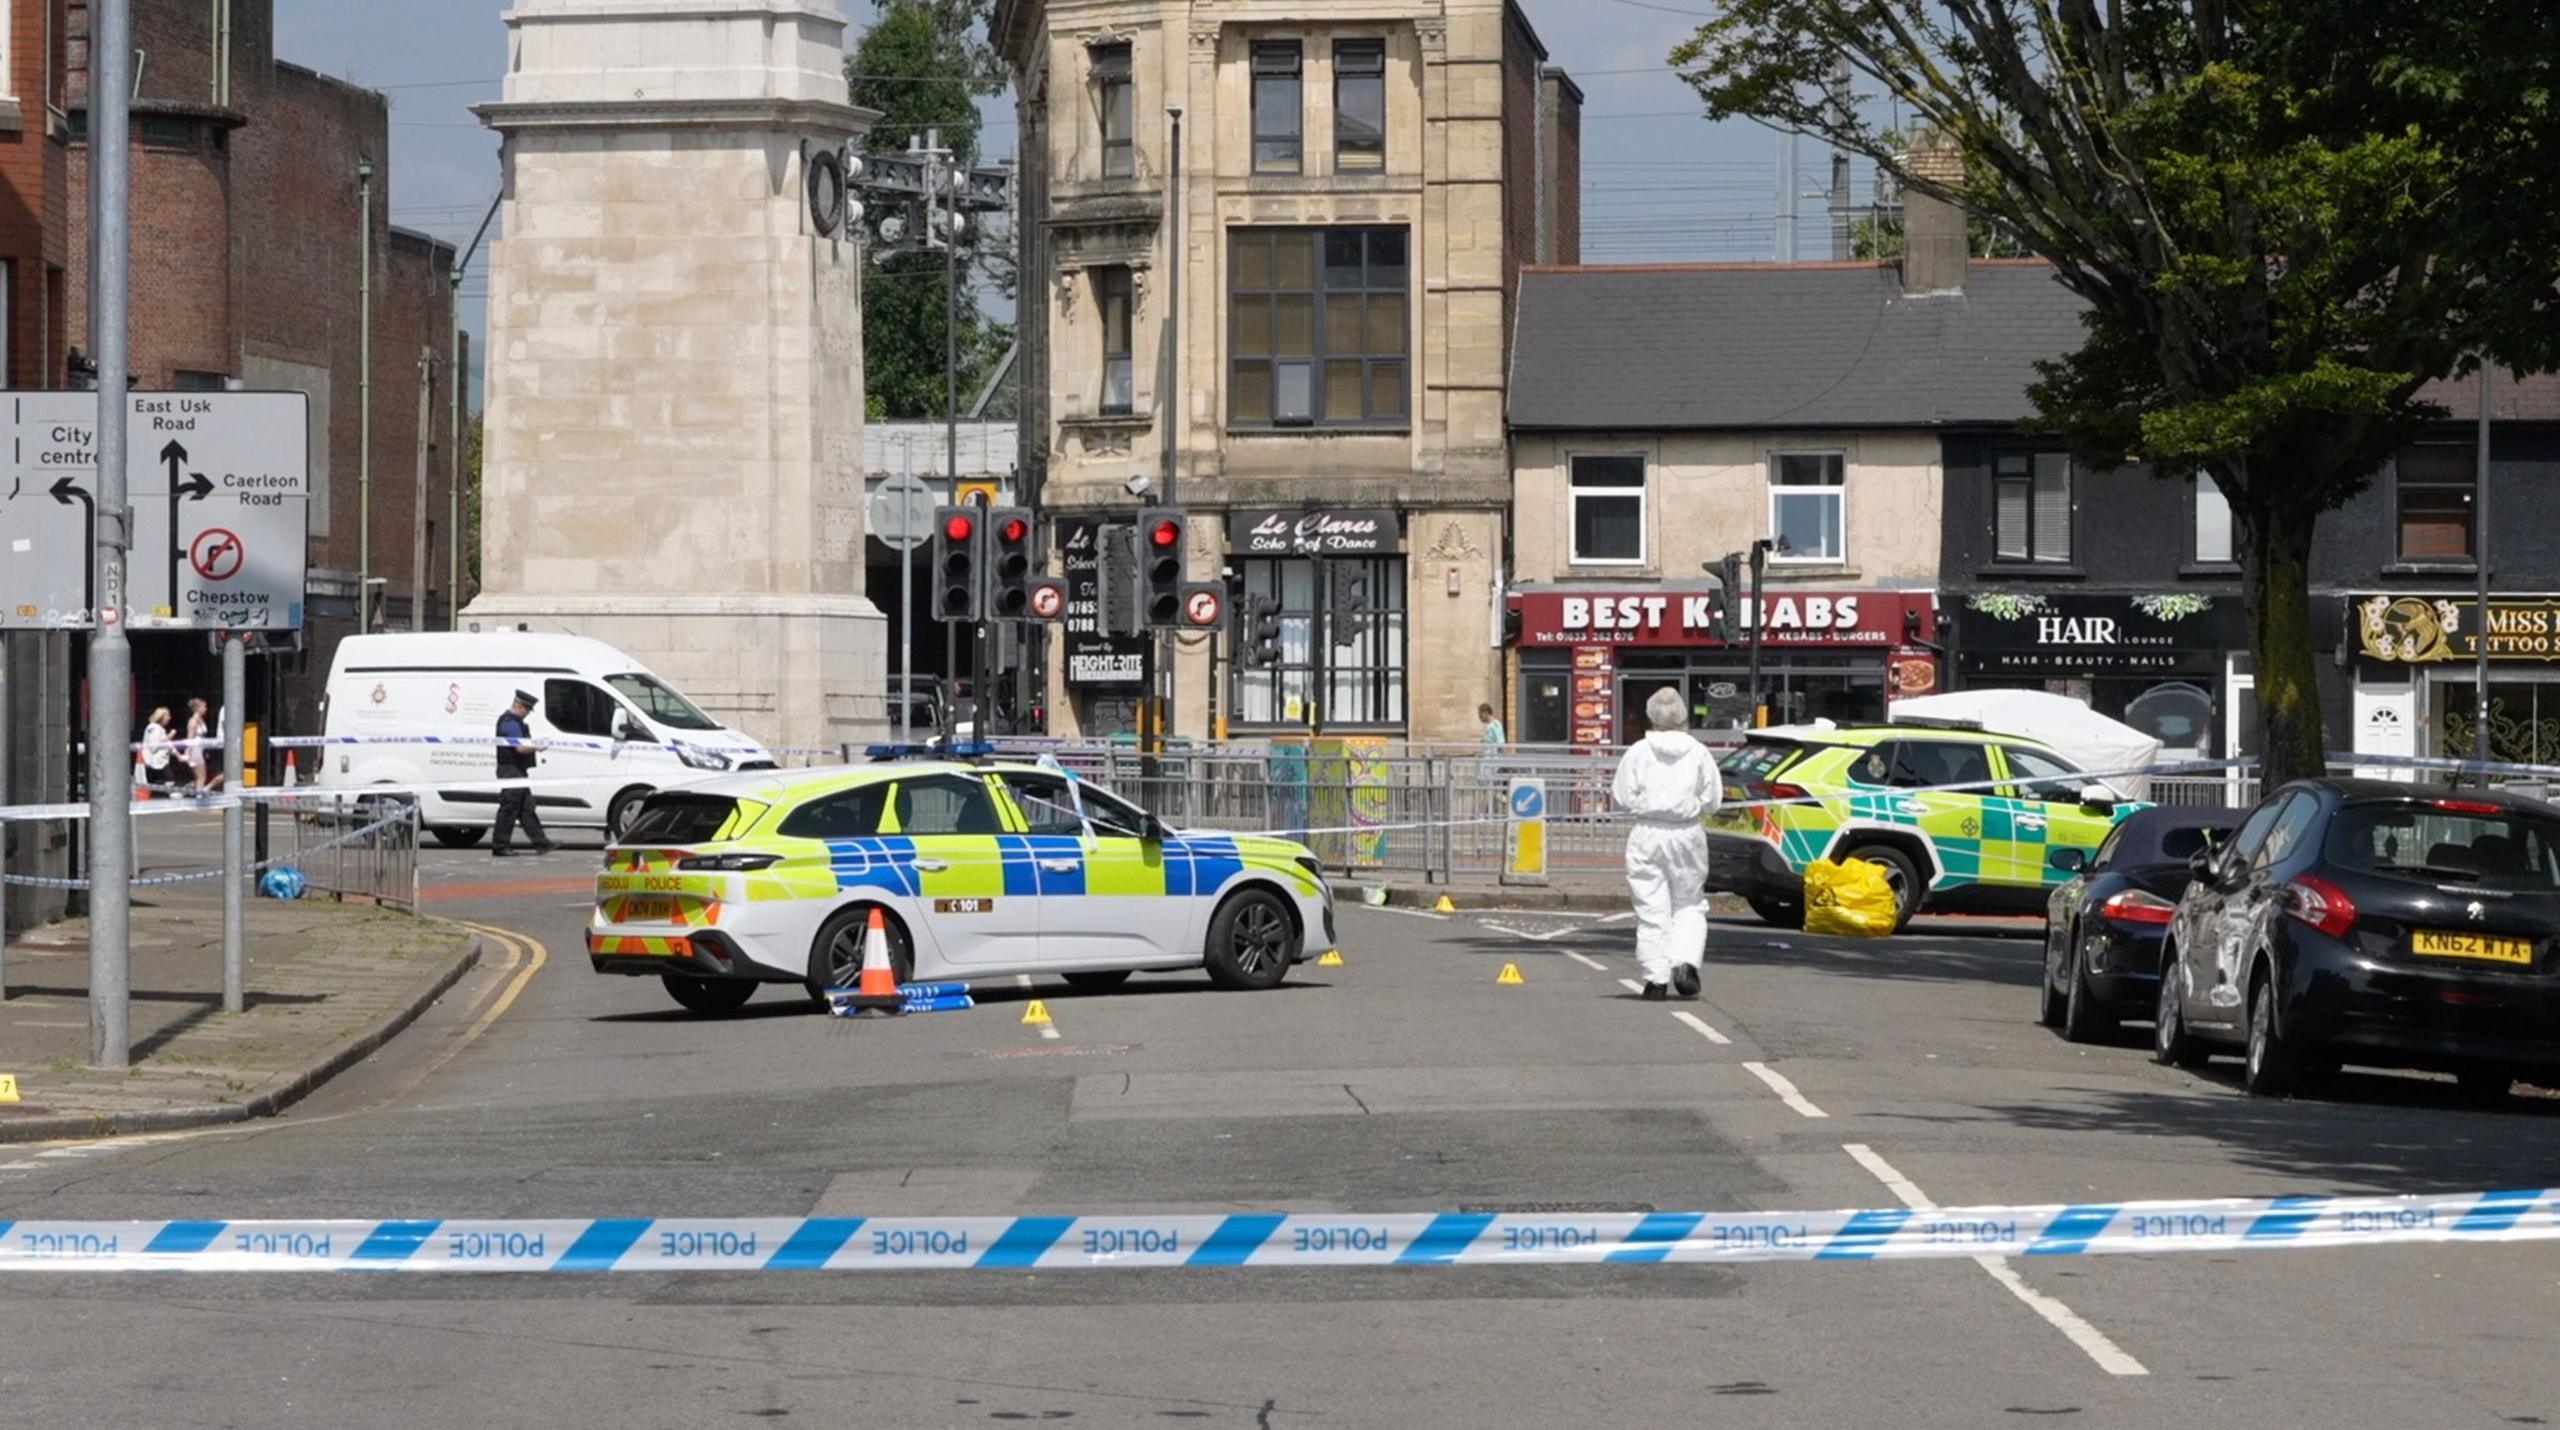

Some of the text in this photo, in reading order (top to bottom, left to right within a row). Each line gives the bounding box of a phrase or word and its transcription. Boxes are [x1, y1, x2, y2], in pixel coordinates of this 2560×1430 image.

[135, 400, 212, 413] East Usk
[153, 417, 196, 430] Road
[51, 427, 93, 446] City
[223, 474, 299, 488] Caerleon
[239, 493, 282, 506] Road
[1326, 535, 1377, 549] Dance
[186, 589, 270, 608] Chepstow
[1562, 597, 1859, 629] BEST KBABS
[2486, 609, 2548, 635] MISS
[1777, 632, 1823, 642] KEBABS
[1832, 632, 1886, 642] BURGERS
[2036, 617, 2174, 645] HAIR LOUNGE
[2464, 635, 2549, 653] TTTOO
[2001, 656, 2176, 666] HAIR BEAUTY NAILS
[643, 877, 682, 889] POLICE
[2422, 933, 2521, 958] KN62 WTA
[3, 1080, 11, 1094] 7
[22, 1233, 118, 1258] POLICE
[235, 1233, 331, 1258] POLICE
[449, 1232, 545, 1258] POLICE
[660, 1231, 756, 1256] POLICE
[872, 1230, 967, 1254] POLICE
[1083, 1229, 1178, 1252] POLICE
[1293, 1227, 1388, 1251] POLICE
[1503, 1226, 1597, 1249] POLICE
[2133, 1214, 2227, 1237] POLICE
